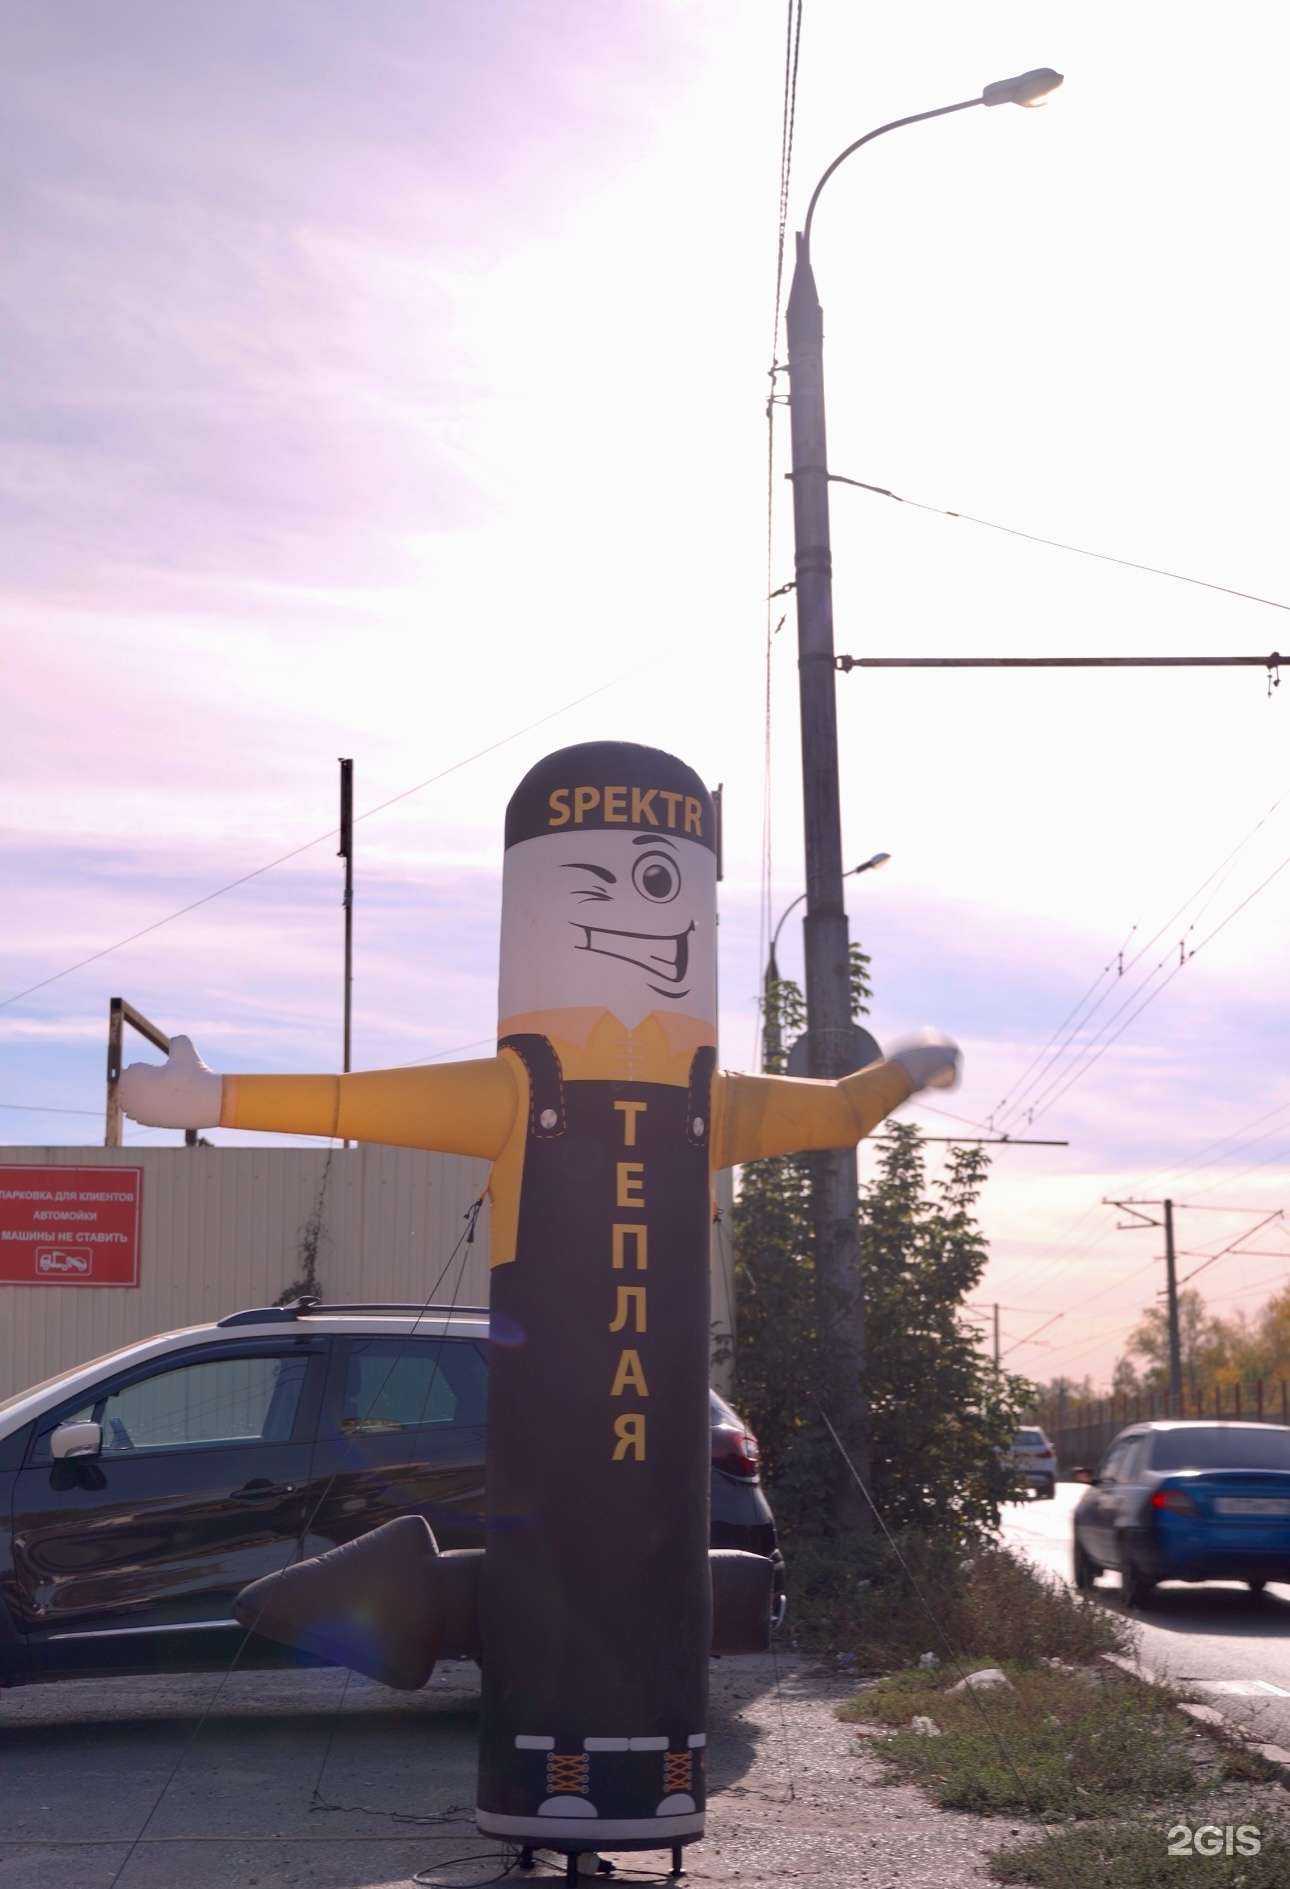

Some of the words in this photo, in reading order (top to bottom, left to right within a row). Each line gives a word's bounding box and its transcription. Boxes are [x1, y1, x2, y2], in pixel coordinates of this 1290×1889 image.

[548, 785, 704, 837] SPEKTR
[0, 1191, 52, 1200] ПАРКОВКА
[55, 1192, 77, 1202] ДЛЯ
[80, 1192, 133, 1201] КЛИЕНТОВ
[33, 1210, 97, 1220] АВТОМОЙКИ
[1, 1231, 55, 1241] МАШИНЫ
[58, 1232, 72, 1242] НЕ
[75, 1233, 127, 1243] СТАВИТЬ
[608, 1100, 650, 1462] ТЕПЛАЯ
